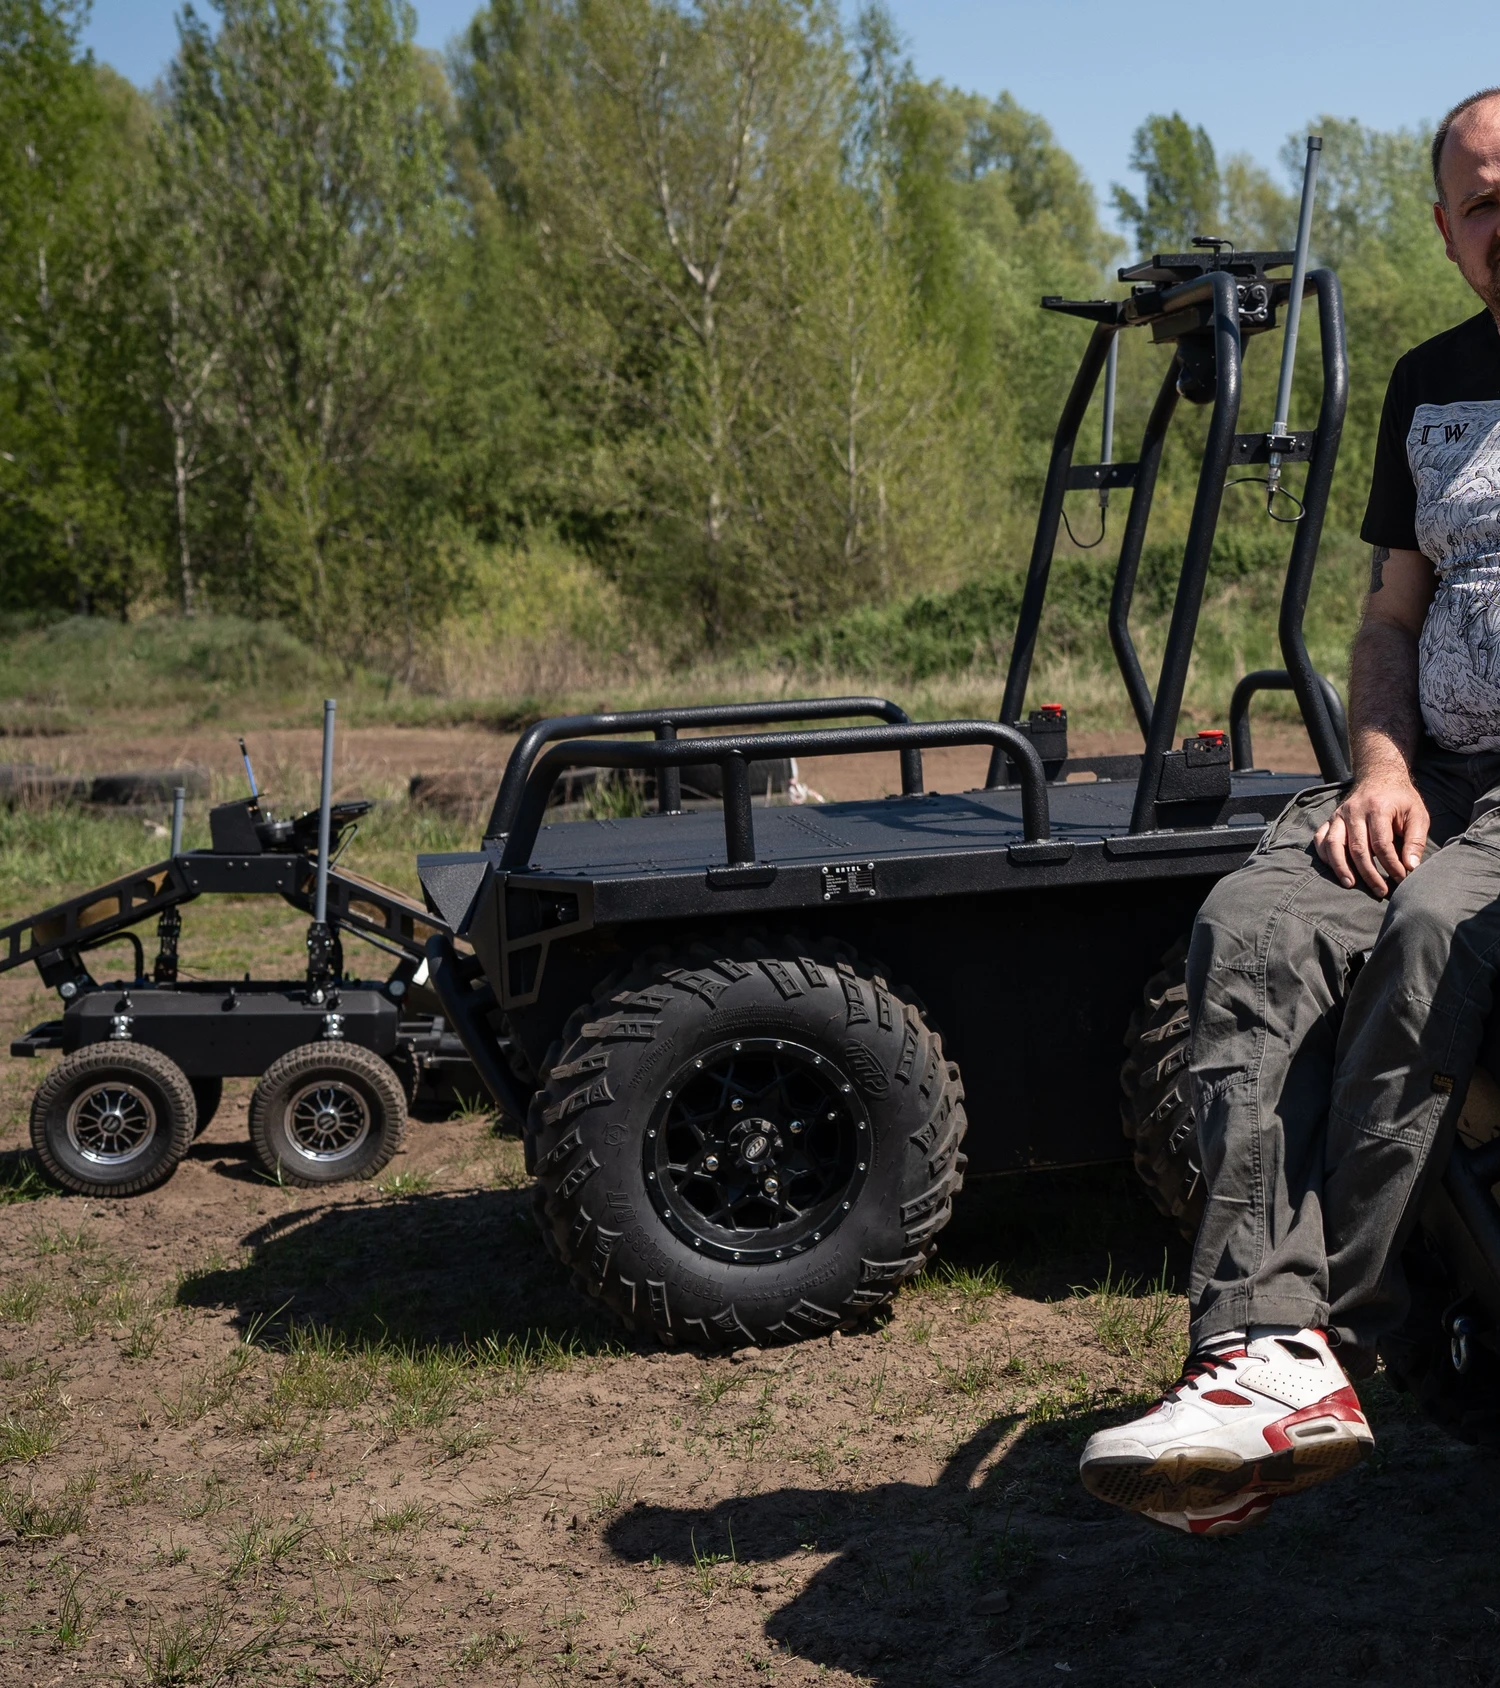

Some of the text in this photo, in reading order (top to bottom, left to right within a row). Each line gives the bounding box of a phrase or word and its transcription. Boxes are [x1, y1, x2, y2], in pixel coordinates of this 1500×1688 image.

[846, 1043, 888, 1092] ITP
[606, 1189, 637, 1224] R/T
[626, 1224, 675, 1277] CROSS
